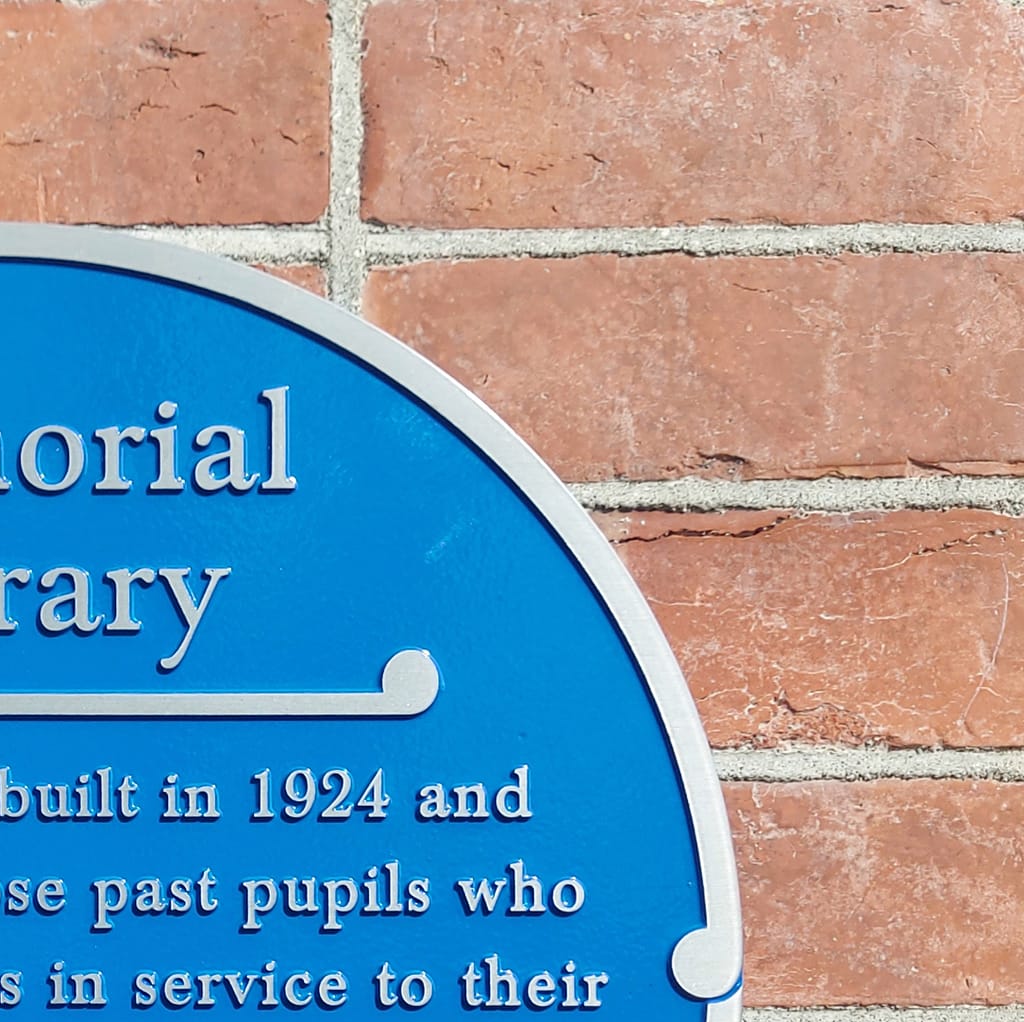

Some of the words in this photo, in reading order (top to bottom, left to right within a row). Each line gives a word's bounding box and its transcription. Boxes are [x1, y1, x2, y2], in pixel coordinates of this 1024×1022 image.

[163, 774, 220, 819] in
[254, 768, 390, 820] 1924
[420, 765, 532, 820] and
[94, 868, 218, 931] past
[243, 860, 431, 931] pupils
[458, 859, 585, 914] who
[50, 961, 106, 1007] in
[136, 961, 346, 1008] service
[376, 964, 433, 1008] to
[462, 954, 609, 1009] their
